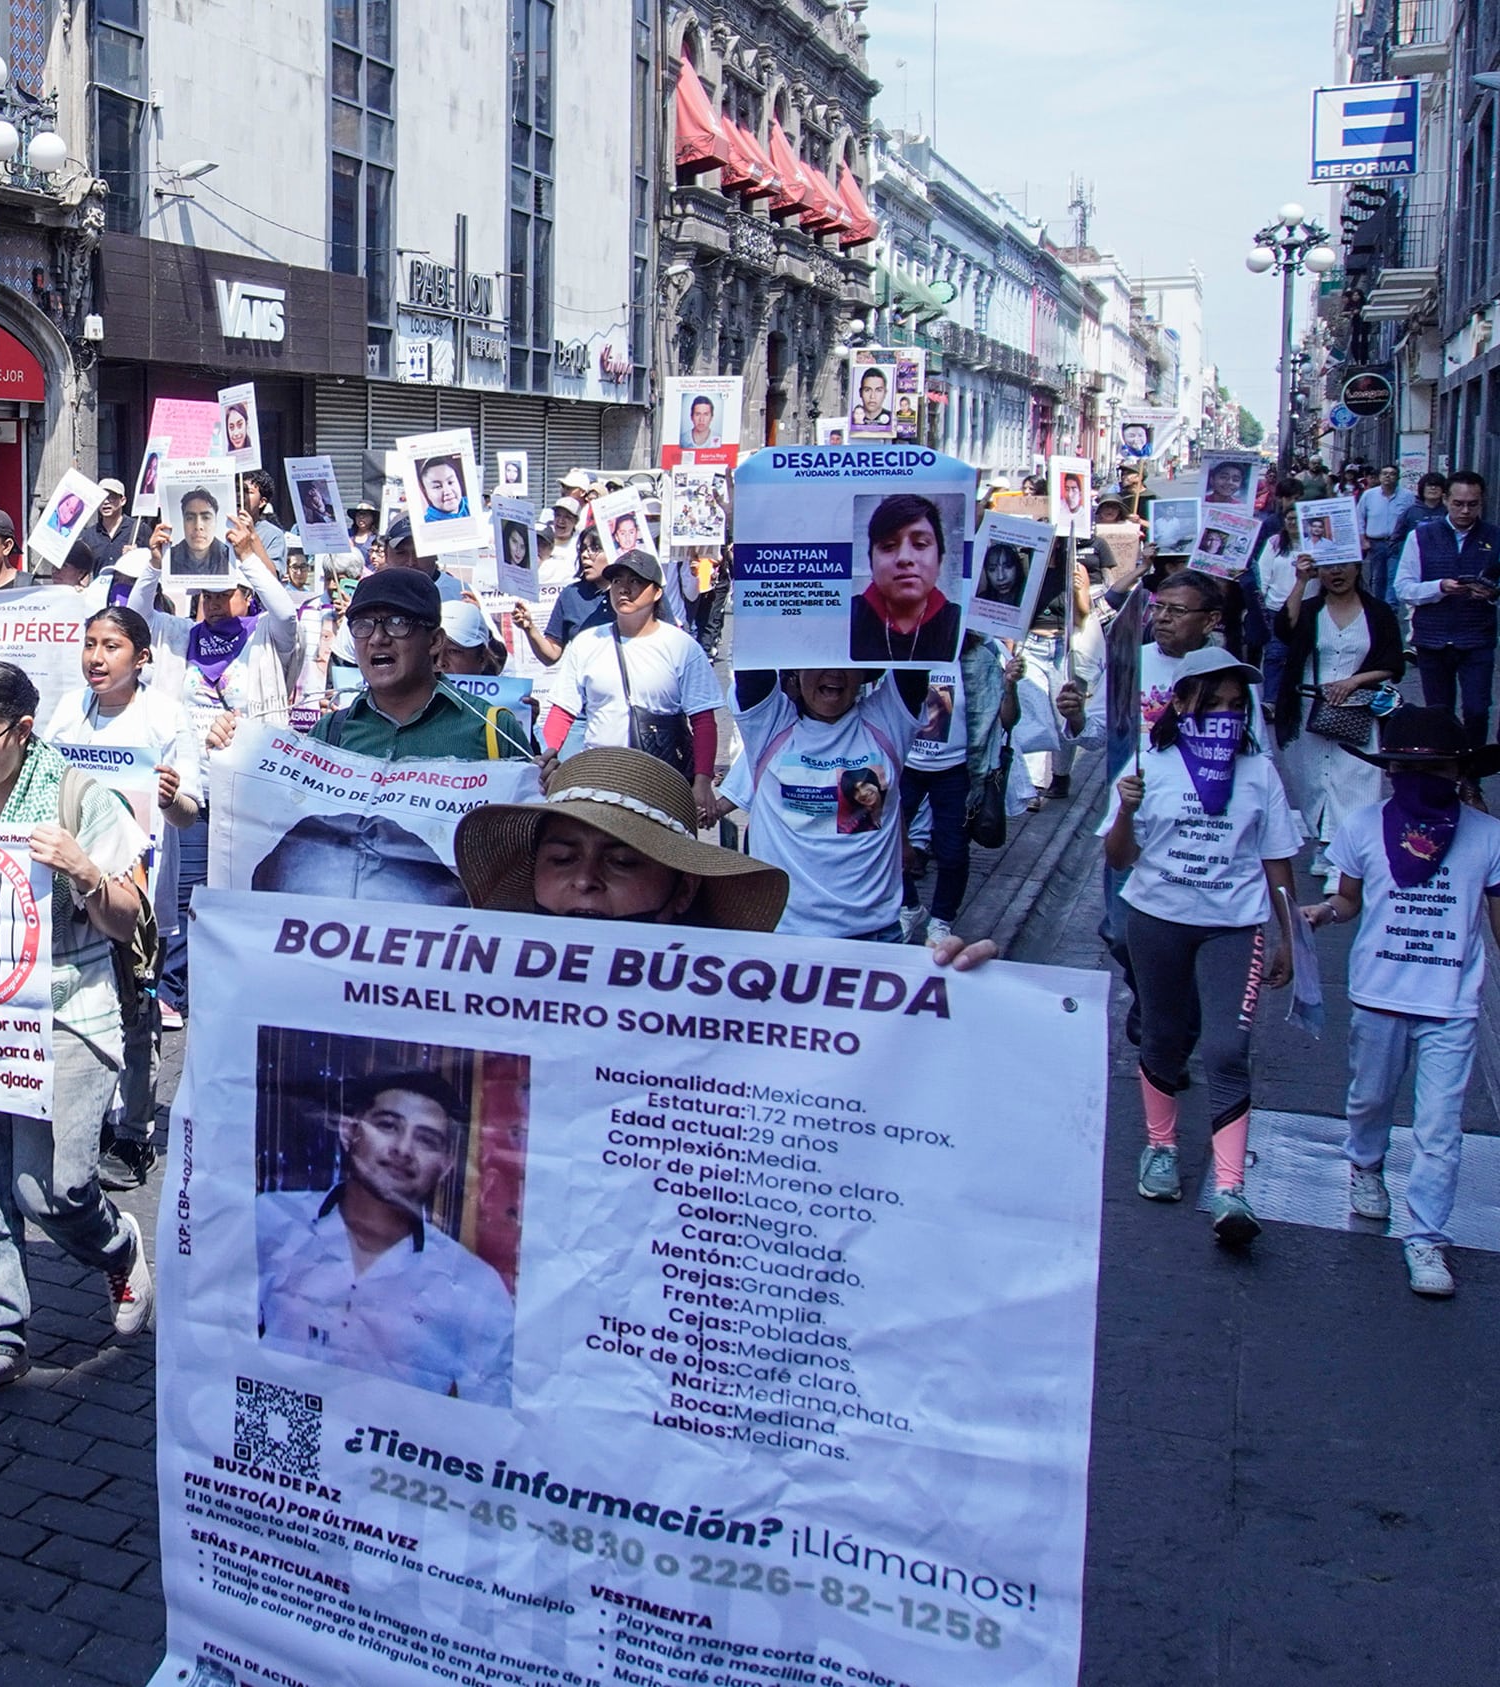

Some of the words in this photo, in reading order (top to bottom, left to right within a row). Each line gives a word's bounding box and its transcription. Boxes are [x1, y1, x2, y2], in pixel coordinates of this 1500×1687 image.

[1316, 158, 1410, 178] REFORMA
[216, 280, 285, 341] VANS
[408, 345, 426, 354] WC
[772, 451, 936, 469] DESAPARECIDO
[795, 469, 840, 477] AYÚDANOS
[852, 469, 914, 477] ENCONTRARLO
[756, 549, 828, 560] JONATHAN
[744, 563, 796, 574] VALDEZ
[798, 563, 844, 574] PALMA
[744, 590, 806, 599] XONACATEPEC,
[808, 590, 840, 598] PUEBLA
[793, 581, 824, 589] MIGUEL
[782, 608, 802, 616] 2025
[13, 617, 80, 643] PÉREZ
[61, 747, 134, 765] PARECIDO
[270, 737, 354, 780] DETENIDO
[370, 769, 488, 790] DESAPARECIDO
[259, 758, 277, 774] 25
[279, 765, 299, 780] DE
[302, 775, 346, 798] MAYO
[348, 788, 370, 803] DE
[408, 794, 432, 808] EN
[1389, 890, 1457, 904] Desaparecidos
[1395, 905, 1406, 914] en
[1386, 925, 1429, 938] Seguimos
[1432, 930, 1443, 939] en
[1446, 931, 1456, 940] la
[1405, 941, 1433, 951] Lucha
[1376, 950, 1463, 967] #HastaEncontrarlo
[274, 917, 503, 974] BOLETÍN
[514, 943, 593, 986] DE
[608, 940, 953, 1021] BÚSQUEDA
[14, 1020, 40, 1034] una
[342, 980, 458, 1015] MISAEL
[463, 992, 610, 1029] ROMERO
[616, 1007, 861, 1057] SOMBRERERO
[33, 1048, 45, 1062] el
[611, 1108, 665, 1130] Edad
[781, 1133, 838, 1154] años
[793, 1113, 876, 1137] metros
[884, 1124, 955, 1149] aprox.
[178, 1118, 192, 1220] CBP-402/2025
[602, 1150, 662, 1172] Color
[667, 1157, 694, 1176] de
[839, 1182, 904, 1206] claro.
[809, 1201, 877, 1224] corto.
[179, 1223, 191, 1256] EXP:
[213, 1456, 275, 1484] BUZÓN
[279, 1474, 302, 1491] DE
[306, 1481, 341, 1504] PAZ
[344, 1426, 484, 1485] ¿Tienes
[491, 1459, 784, 1549] información?
[791, 1525, 1038, 1612] ¡Llámanos!
[190, 1529, 238, 1554] SEÑAS
[240, 1543, 351, 1595] PARTICULARES
[654, 1553, 680, 1577] o
[688, 1554, 1002, 1651] 2226-82-1258
